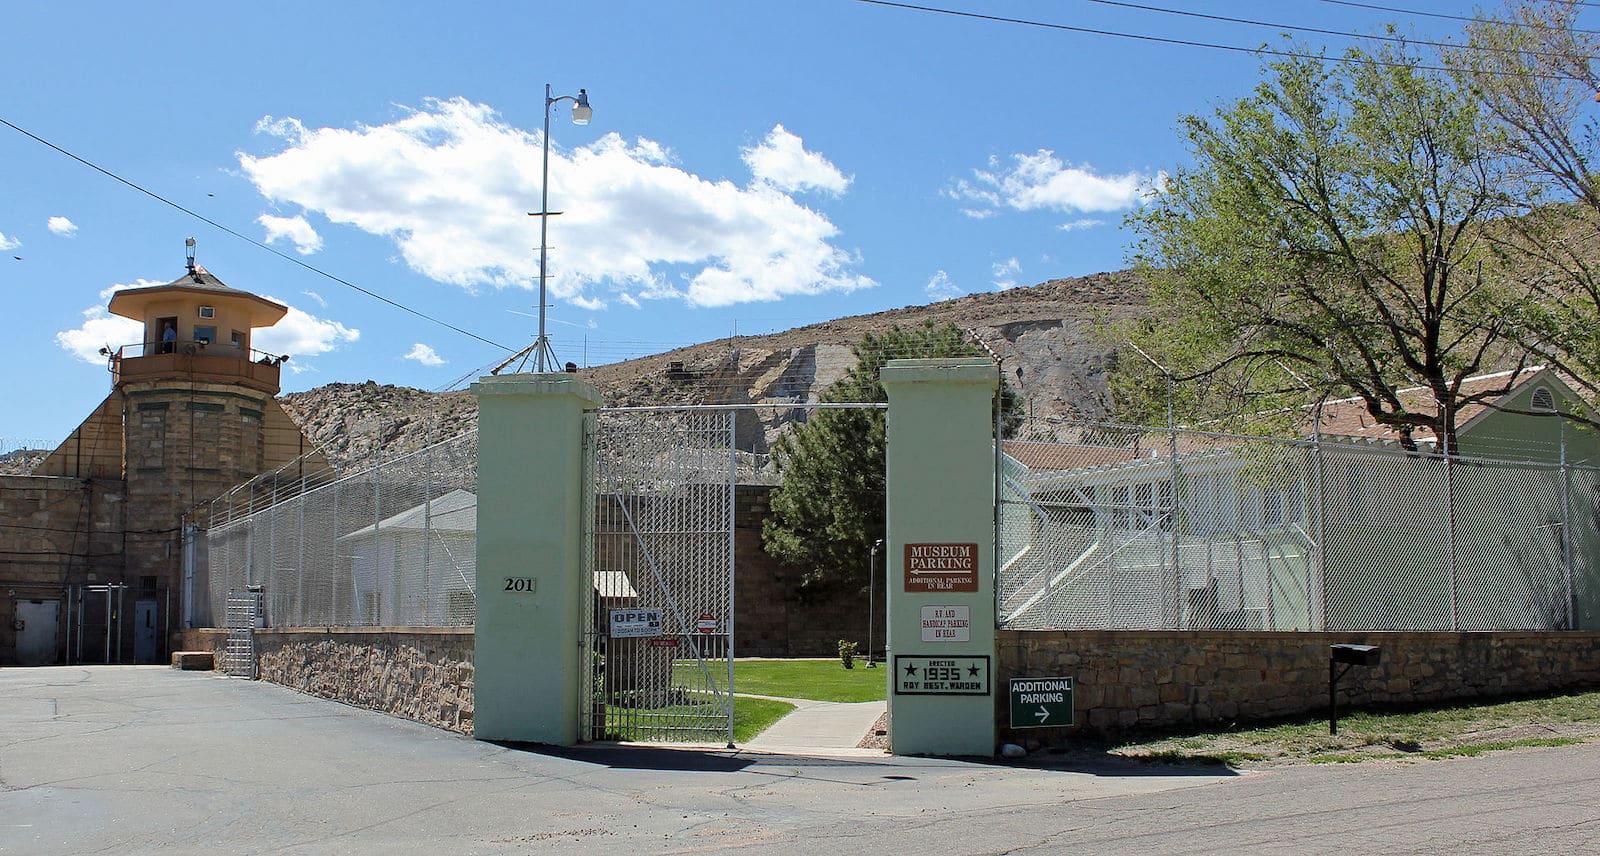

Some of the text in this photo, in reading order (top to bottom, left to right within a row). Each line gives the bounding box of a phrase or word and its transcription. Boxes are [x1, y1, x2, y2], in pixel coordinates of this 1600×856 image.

[912, 547, 969, 557] MUSEUM
[911, 558, 971, 568] PARKING
[505, 578, 533, 591] 201
[615, 613, 657, 622] OPEN
[945, 610, 955, 618] AND
[923, 620, 968, 628] HANDICAP PARKING
[924, 668, 960, 680] 1935
[1012, 681, 1071, 692] ADDITIONAL
[1021, 693, 1063, 704] PARKING
